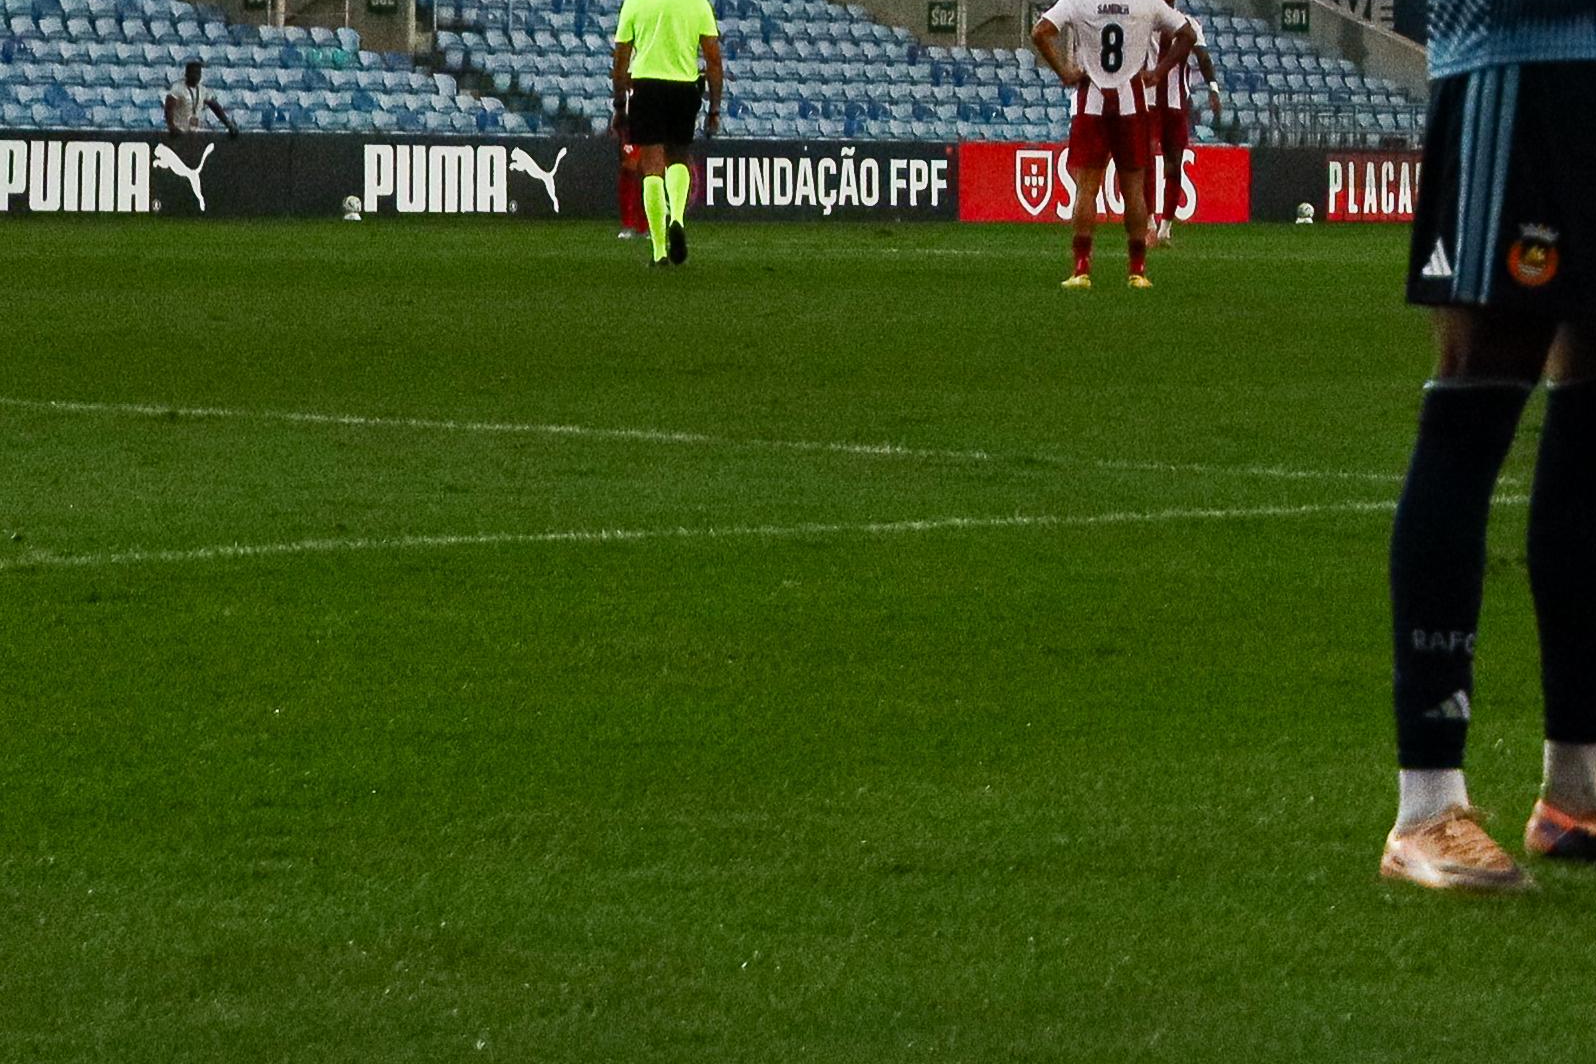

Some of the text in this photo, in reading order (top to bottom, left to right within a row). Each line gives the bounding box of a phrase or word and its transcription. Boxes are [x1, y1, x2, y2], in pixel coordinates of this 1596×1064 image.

[1100, 23, 1124, 74] 8
[0, 139, 150, 212] PUMA
[364, 144, 507, 213] PUMA
[706, 146, 948, 215] FUNDAÇÃO FPF
